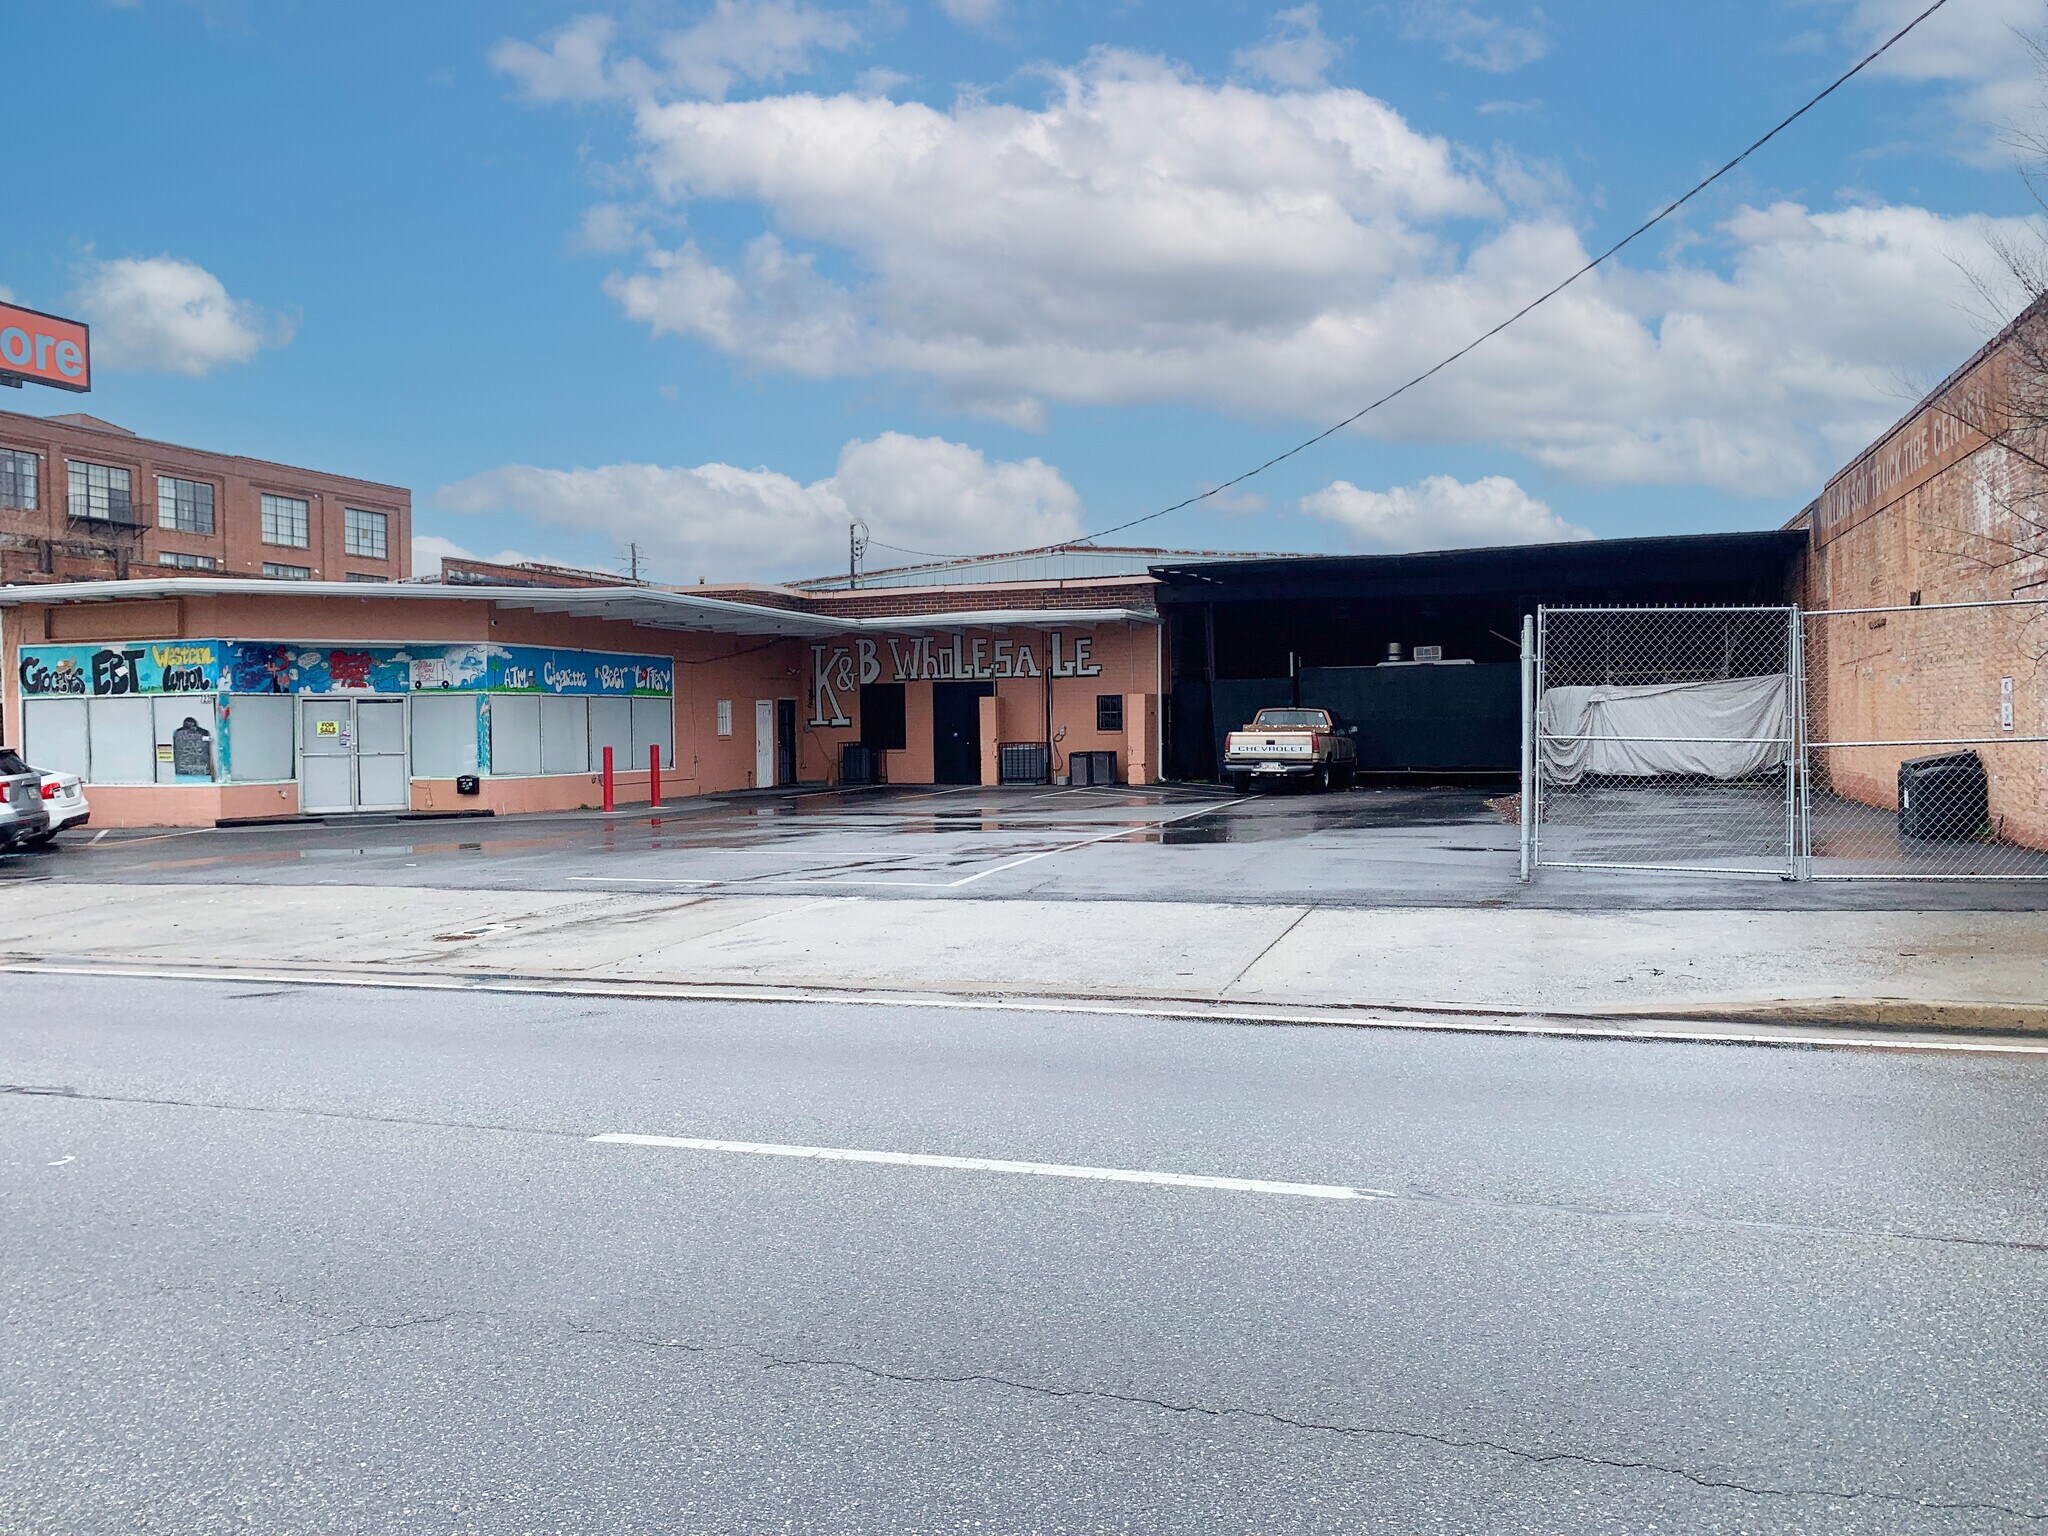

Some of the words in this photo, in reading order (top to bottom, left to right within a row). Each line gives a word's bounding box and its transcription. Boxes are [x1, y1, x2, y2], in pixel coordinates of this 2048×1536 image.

[0, 327, 83, 377] ore
[1871, 447, 1902, 500] TRUCK
[1903, 427, 1929, 477] TIRE
[1933, 387, 1986, 457] CENTER
[91, 649, 146, 695] EBT
[152, 645, 215, 668] Western
[162, 664, 211, 693] Union
[544, 661, 587, 692] Cigarette
[601, 664, 629, 689] Beer
[809, 637, 882, 727] K&B
